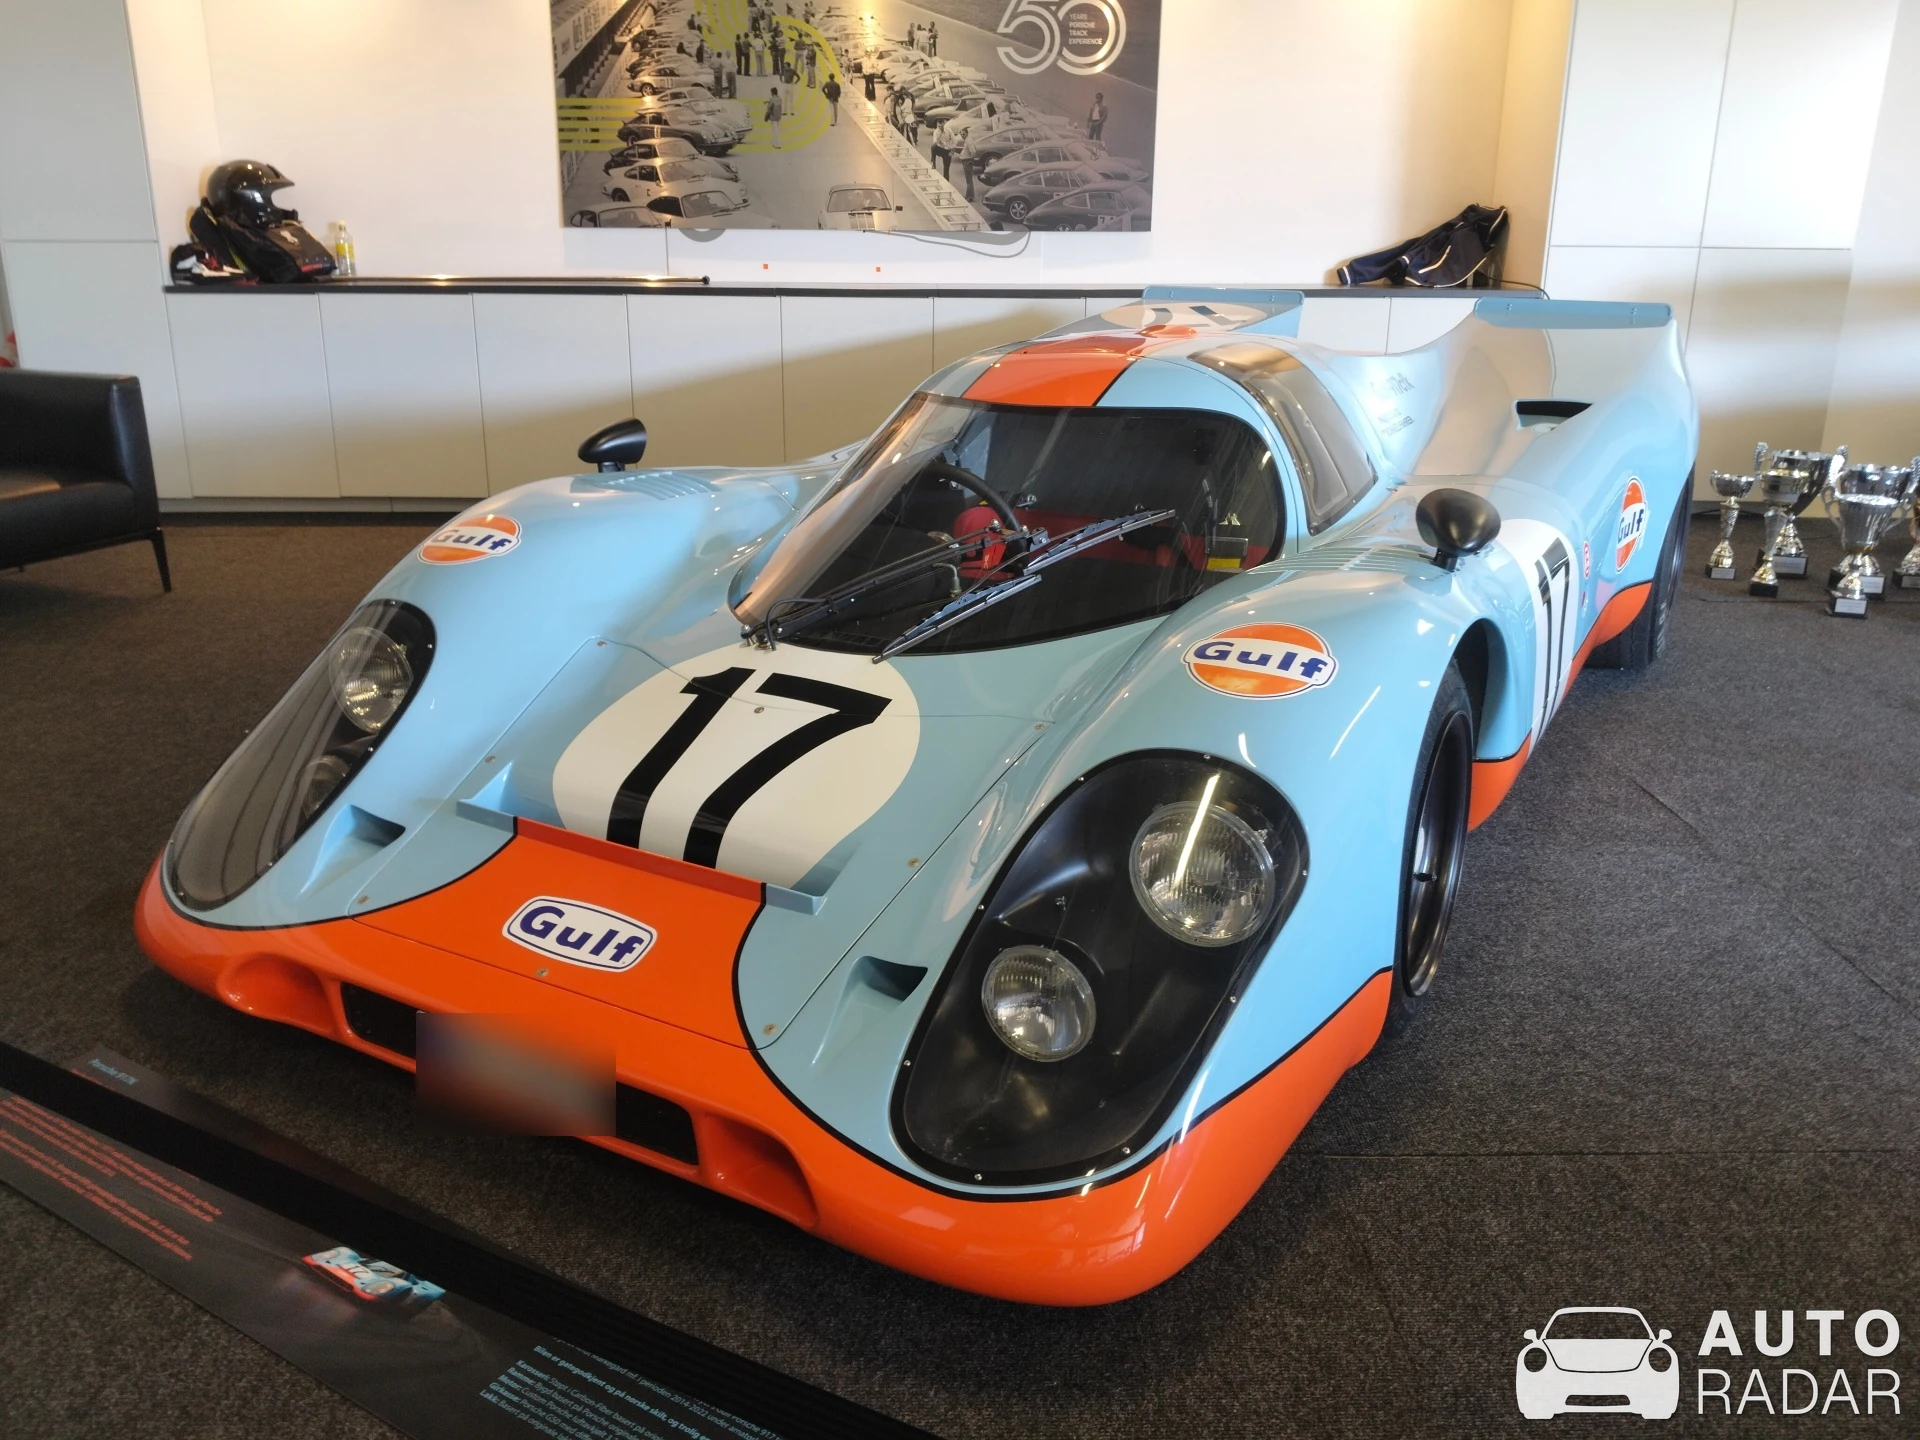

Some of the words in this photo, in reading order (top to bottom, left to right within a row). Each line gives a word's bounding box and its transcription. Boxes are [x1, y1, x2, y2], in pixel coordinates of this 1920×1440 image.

[997, 0, 1127, 75] 50
[430, 529, 513, 551] Gulf
[1617, 508, 1645, 544] Gulf
[1193, 641, 1329, 679] Gulf
[1534, 536, 1570, 741] 17
[604, 666, 894, 870] 17
[519, 905, 645, 963] Gulf
[533, 1345, 553, 1358] Bilen
[604, 1384, 616, 1394] og
[612, 1389, 627, 1398] på
[624, 1395, 650, 1411] norske
[667, 1418, 680, 1428] og
[678, 1423, 701, 1439] trolig
[670, 1394, 709, 1417] 2014-2022
[706, 1414, 730, 1428] under
